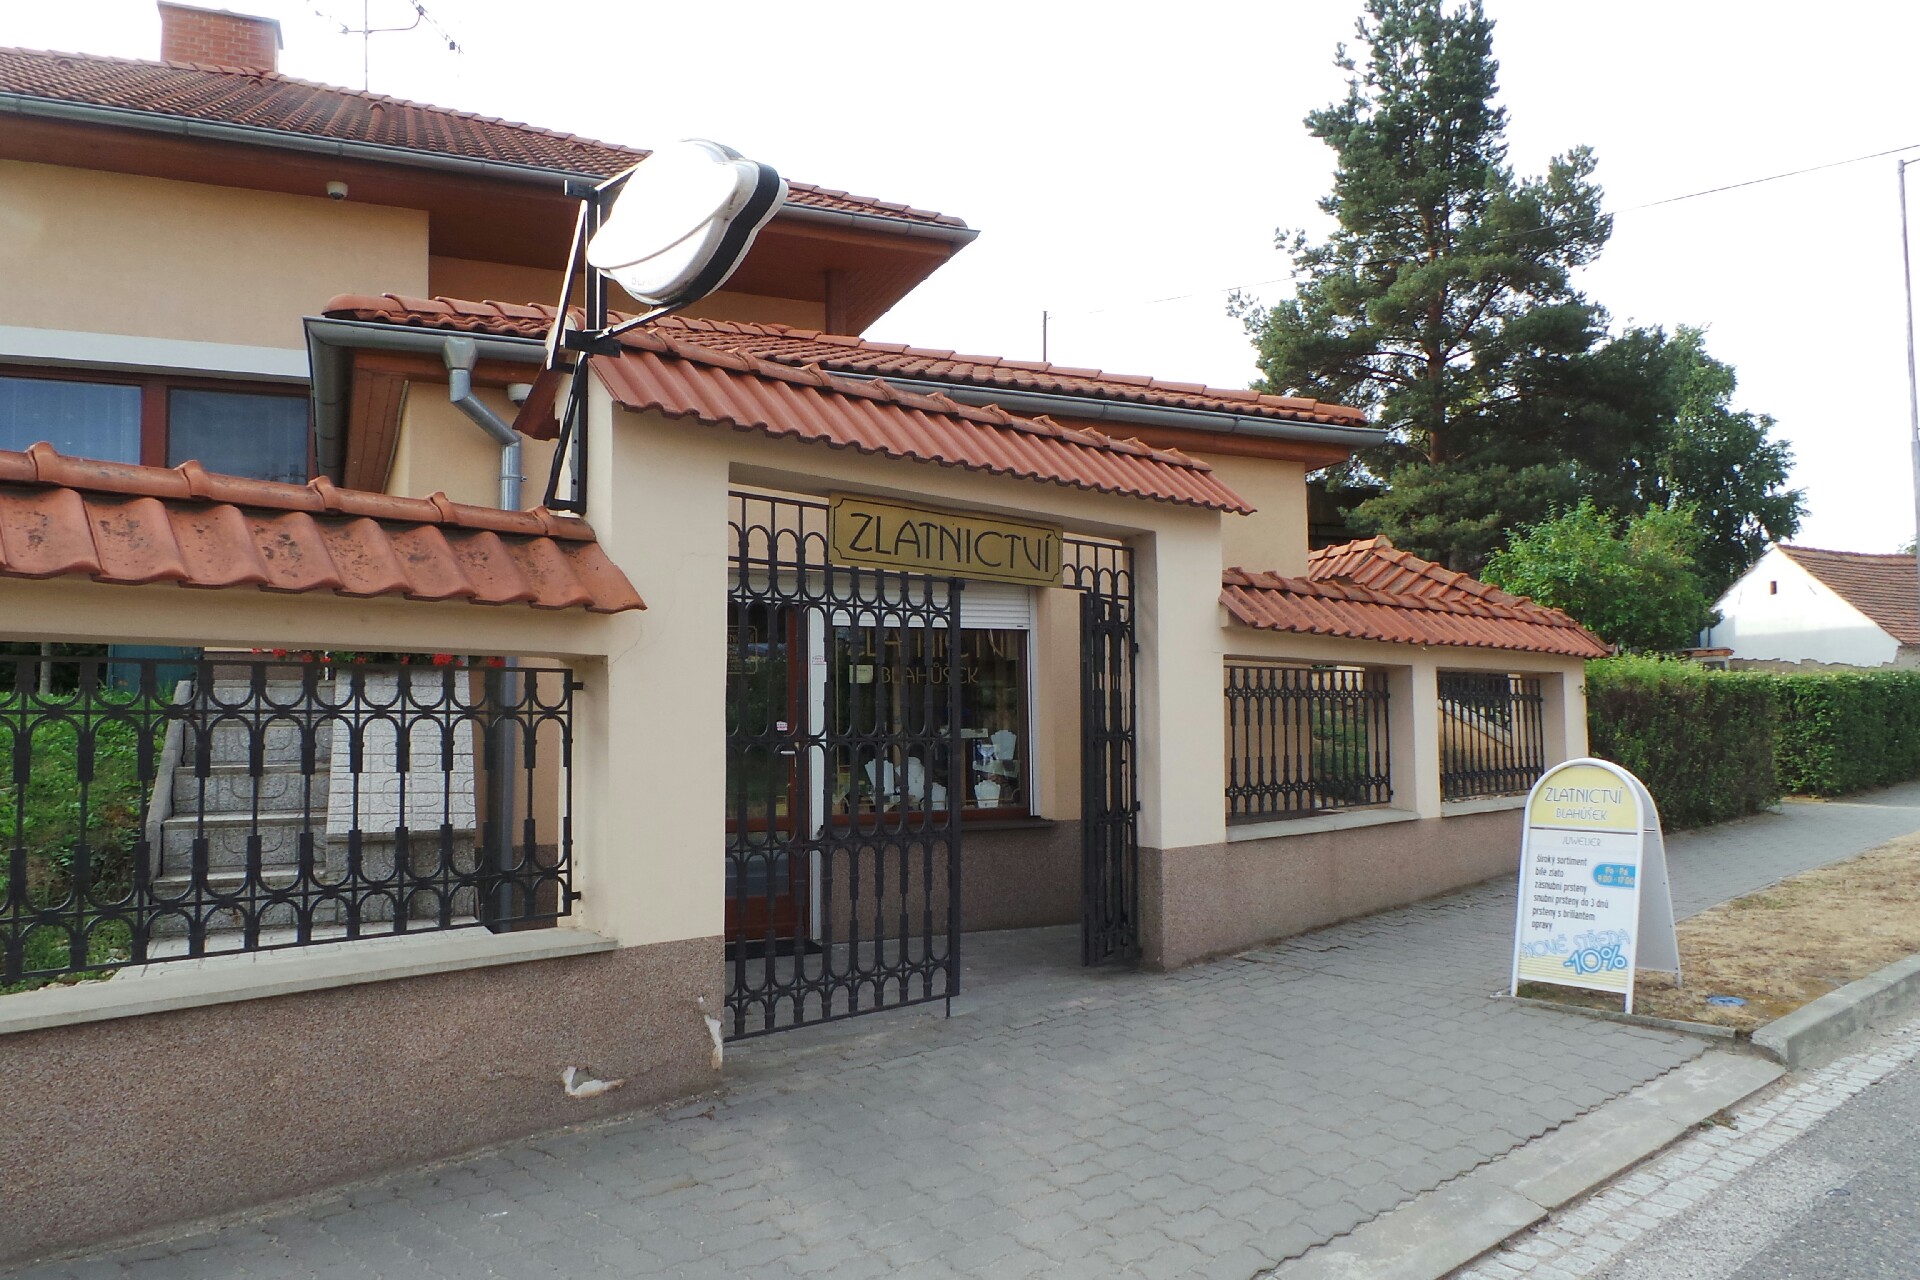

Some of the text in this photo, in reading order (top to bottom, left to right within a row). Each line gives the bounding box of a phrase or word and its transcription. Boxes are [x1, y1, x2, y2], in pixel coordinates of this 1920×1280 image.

[849, 512, 1052, 573] ZLATNICTVÍ
[1544, 786, 1623, 804] ZLATNICTVÍ
[1557, 856, 1587, 866] sortiment
[1549, 867, 1564, 877] zlato
[1563, 884, 1587, 895] prsteny
[1555, 896, 1579, 908] prsteny
[1581, 897, 1589, 907] do
[1590, 898, 1595, 908] 3
[1532, 907, 1556, 919] prsteny
[1563, 944, 1629, 975] -10%
